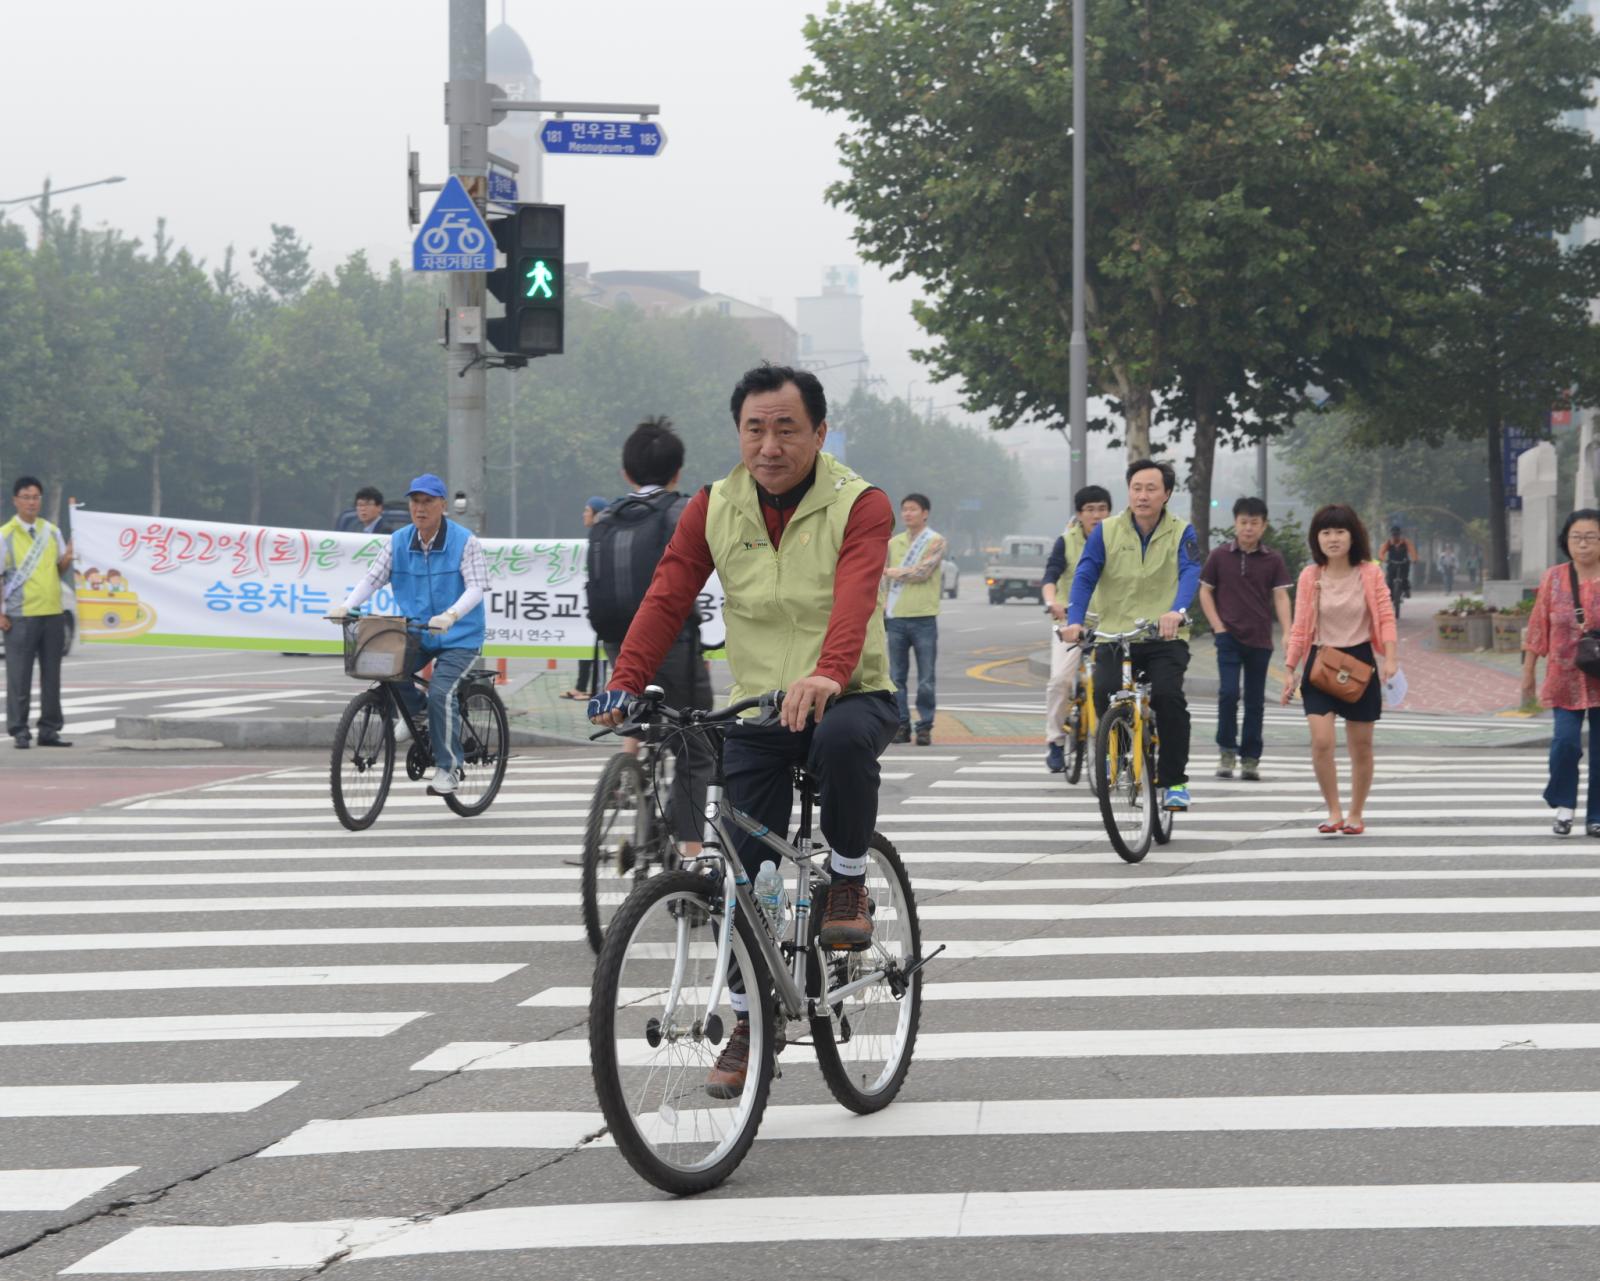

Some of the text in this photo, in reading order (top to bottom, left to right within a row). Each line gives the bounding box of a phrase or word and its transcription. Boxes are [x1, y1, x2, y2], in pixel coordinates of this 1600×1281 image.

[546, 130, 562, 143] 181
[571, 123, 632, 140] 먼우금로
[640, 133, 658, 146] 185
[568, 141, 635, 154] Meonugeum-ro
[422, 255, 486, 269] 자전거횡단
[203, 580, 330, 614] 승용차는
[491, 590, 590, 620] 대중교
[527, 628, 565, 642] 연수구
